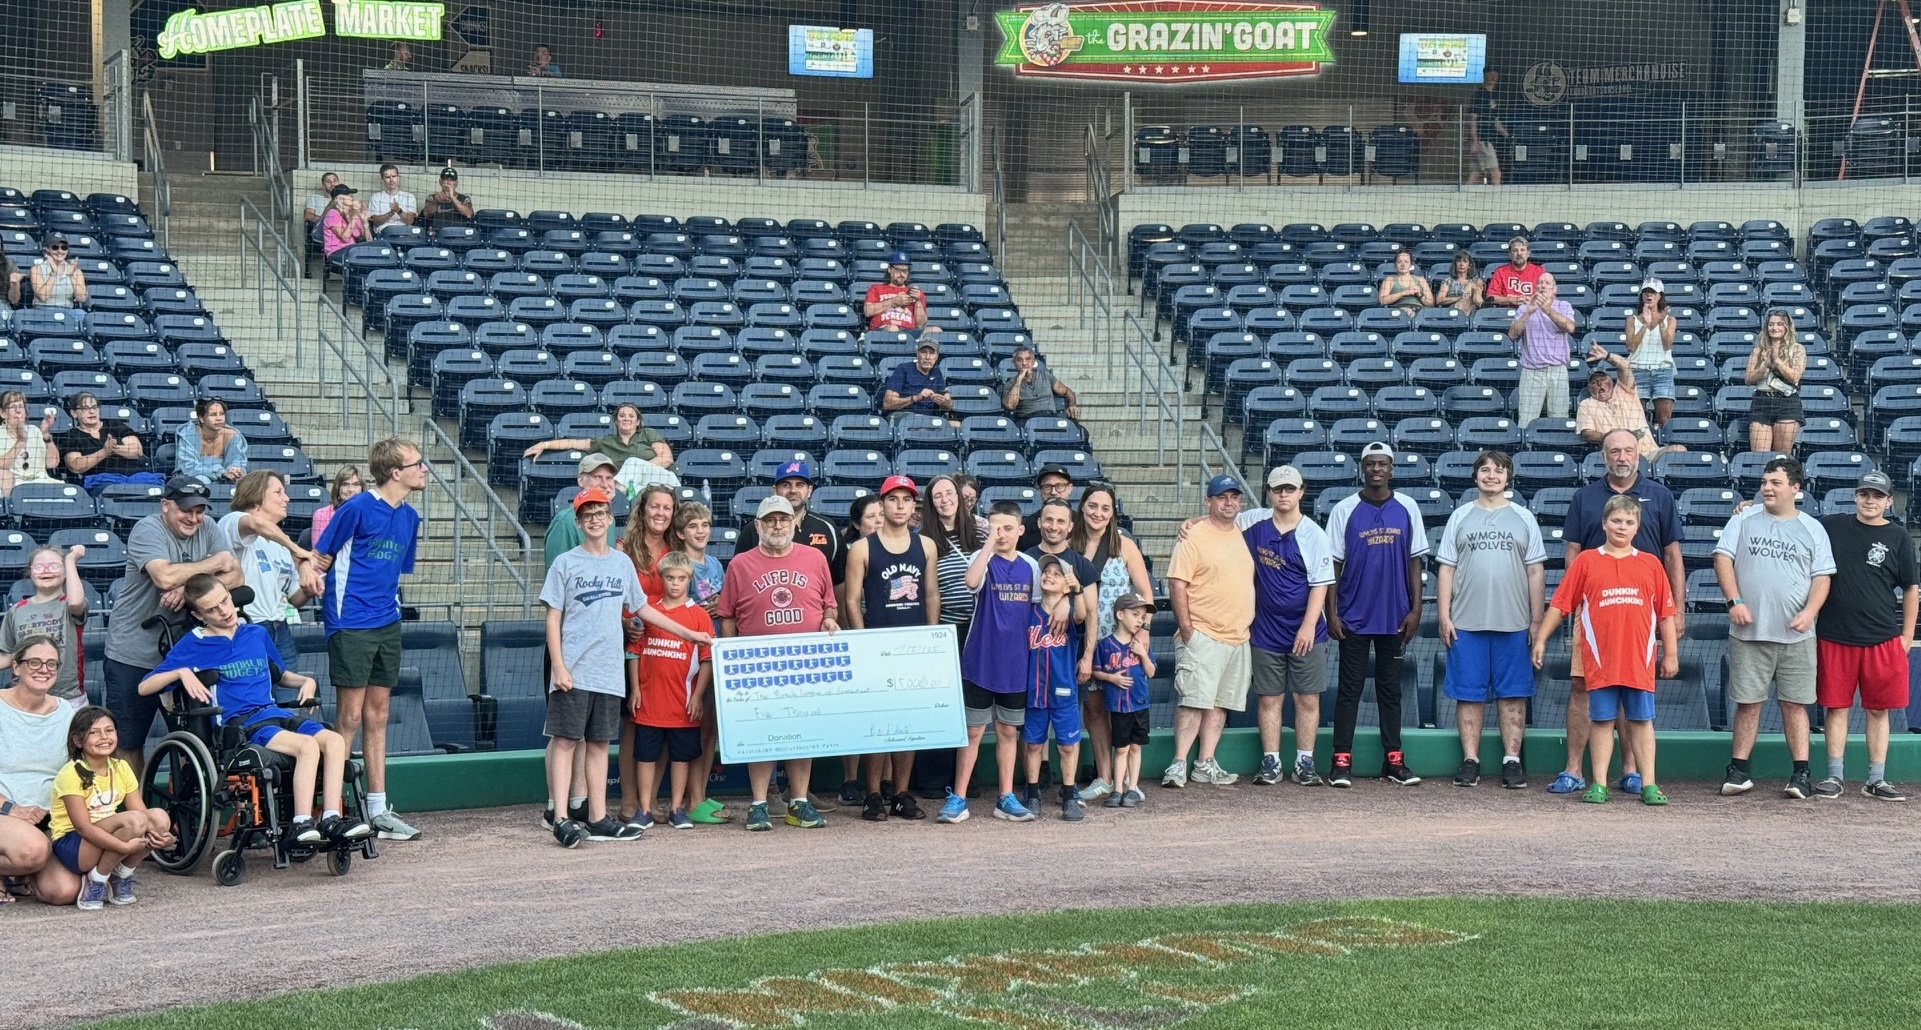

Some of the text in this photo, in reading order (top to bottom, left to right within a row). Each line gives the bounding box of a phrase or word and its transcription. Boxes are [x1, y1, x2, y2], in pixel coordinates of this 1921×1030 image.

[157, 2, 443, 57] HOMEPLATE MARKET
[1085, 29, 1106, 45] the
[1233, 21, 1319, 51] GOAT
[1604, 62, 1686, 83] MERCHANDISE
[1508, 276, 1533, 295] RG
[880, 311, 913, 324] SCREAM
[1466, 531, 1514, 541] WMGNA
[1467, 541, 1513, 551] WOLVES
[1750, 536, 1798, 553] WMGNA
[1748, 547, 1795, 563] WOLVES
[881, 563, 921, 580] OLD NAVY
[575, 575, 623, 590] Rocky Hill
[791, 570, 808, 589] IS
[999, 591, 1029, 602] WIZARDS
[1601, 587, 1639, 598] DUNKIN'
[1599, 597, 1644, 608] MUNCHKINS
[765, 608, 804, 626] GOOD
[648, 637, 683, 649] DUNKIN'
[643, 648, 688, 660] MUNCHKINS
[219, 658, 266, 671] RANKLIN
[222, 667, 266, 679] IDGETS
[886, 678, 894, 688] $
[768, 733, 801, 742] Donation
